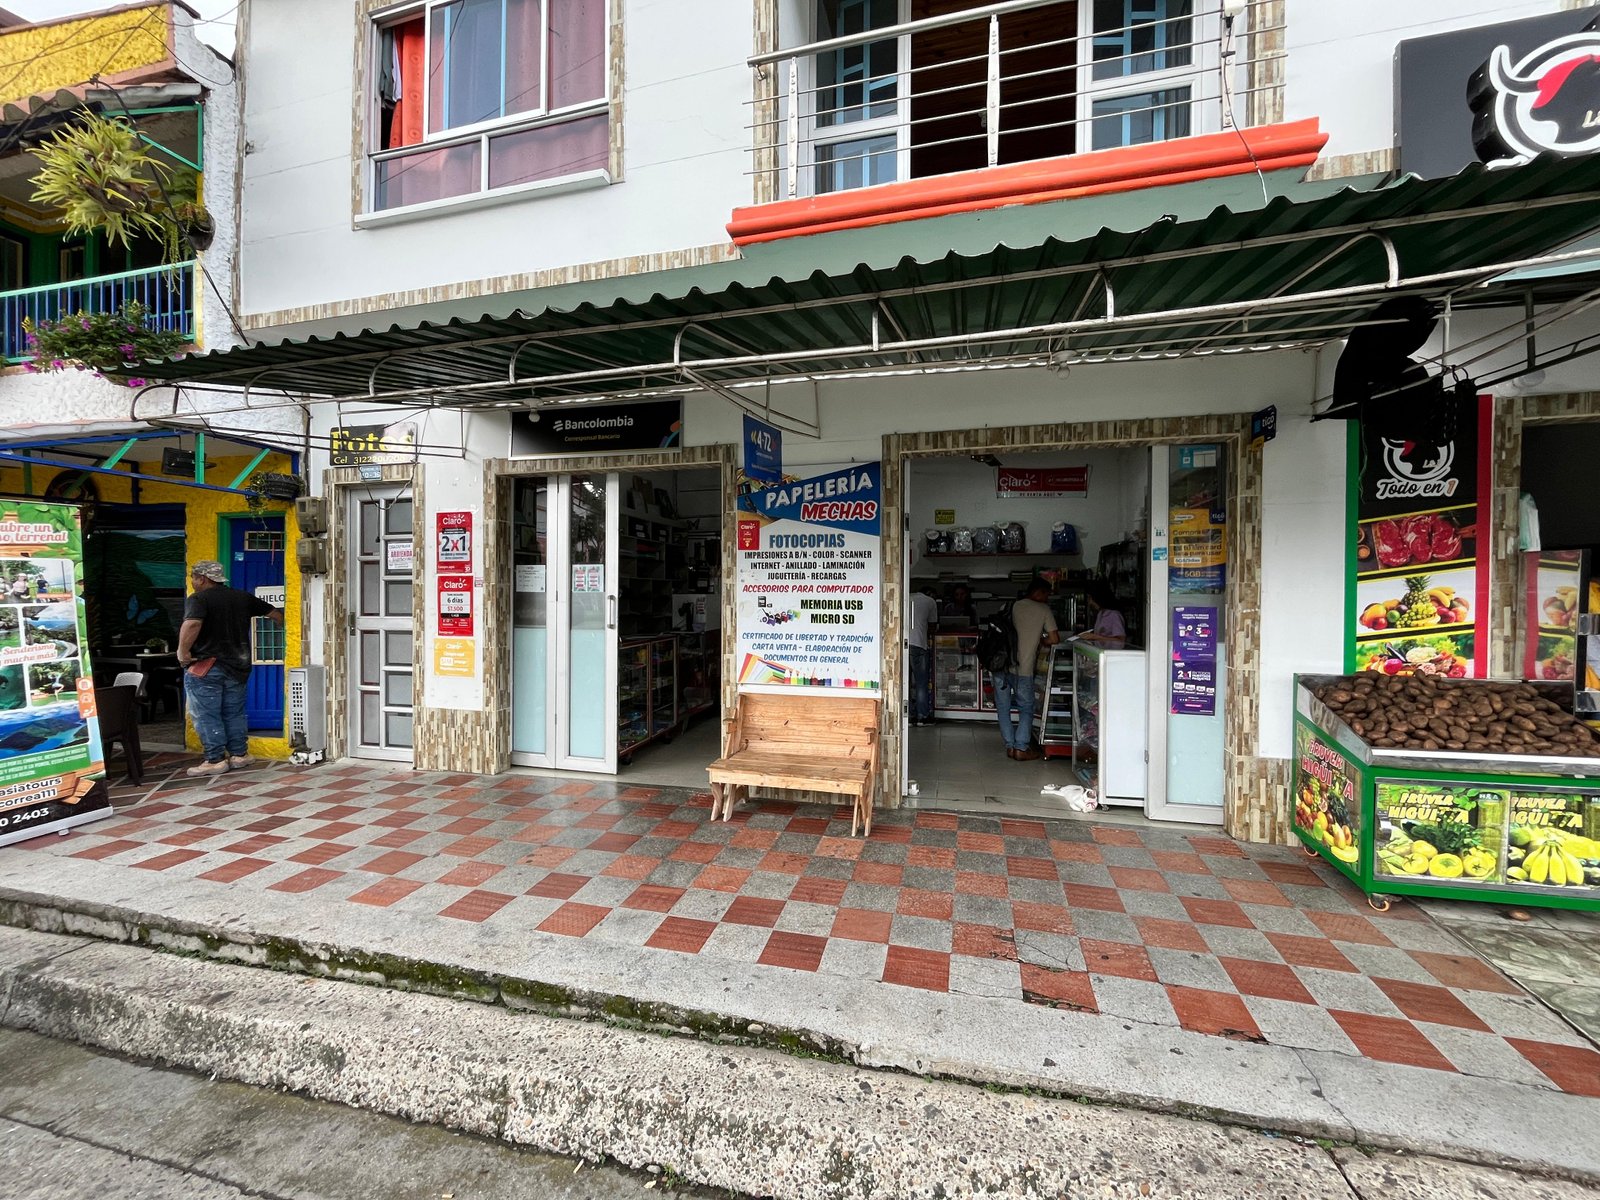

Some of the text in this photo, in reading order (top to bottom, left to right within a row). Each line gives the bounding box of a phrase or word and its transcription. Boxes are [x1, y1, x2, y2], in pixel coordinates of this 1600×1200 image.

[565, 415, 634, 430] Bancolombia
[333, 456, 348, 465] Cel
[999, 477, 1031, 487] Claro
[765, 470, 873, 510] PAPELERÍA
[1379, 480, 1456, 497] Todo en 1
[801, 501, 877, 521] MECHAS
[442, 517, 462, 525] Claro
[16, 532, 66, 541] terrenal
[769, 534, 845, 548] FOTOCOPIAS
[441, 535, 466, 552] 2x1
[744, 550, 872, 559] IMPRESIONES A B/N COLOR SCANNER
[750, 562, 780, 570] INTERNET
[822, 560, 865, 570] LAMINACIÓN
[767, 571, 847, 580] JUGUETERÍA RECARGAS
[743, 585, 874, 593] ACCESORIOS PARA COMPUTADOR
[800, 599, 863, 610] MEMORIA USB
[810, 614, 855, 624] MICRO SD
[742, 632, 784, 640] CERTIFICADO
[795, 633, 828, 641] LIBERTAD
[836, 633, 874, 643] TRADICIÓN
[4, 643, 55, 655] Senderismo
[752, 643, 774, 651] CARTA
[776, 643, 797, 651] VENTA
[805, 643, 851, 653] ELABORACIÓN
[763, 654, 808, 662] DOCUMENTOS
[820, 656, 849, 664] GENERAL
[1309, 740, 1343, 769] FRUVER
[0, 777, 61, 797] asiatours
[1400, 792, 1454, 806] FRUVER
[12, 807, 49, 824] 2403
